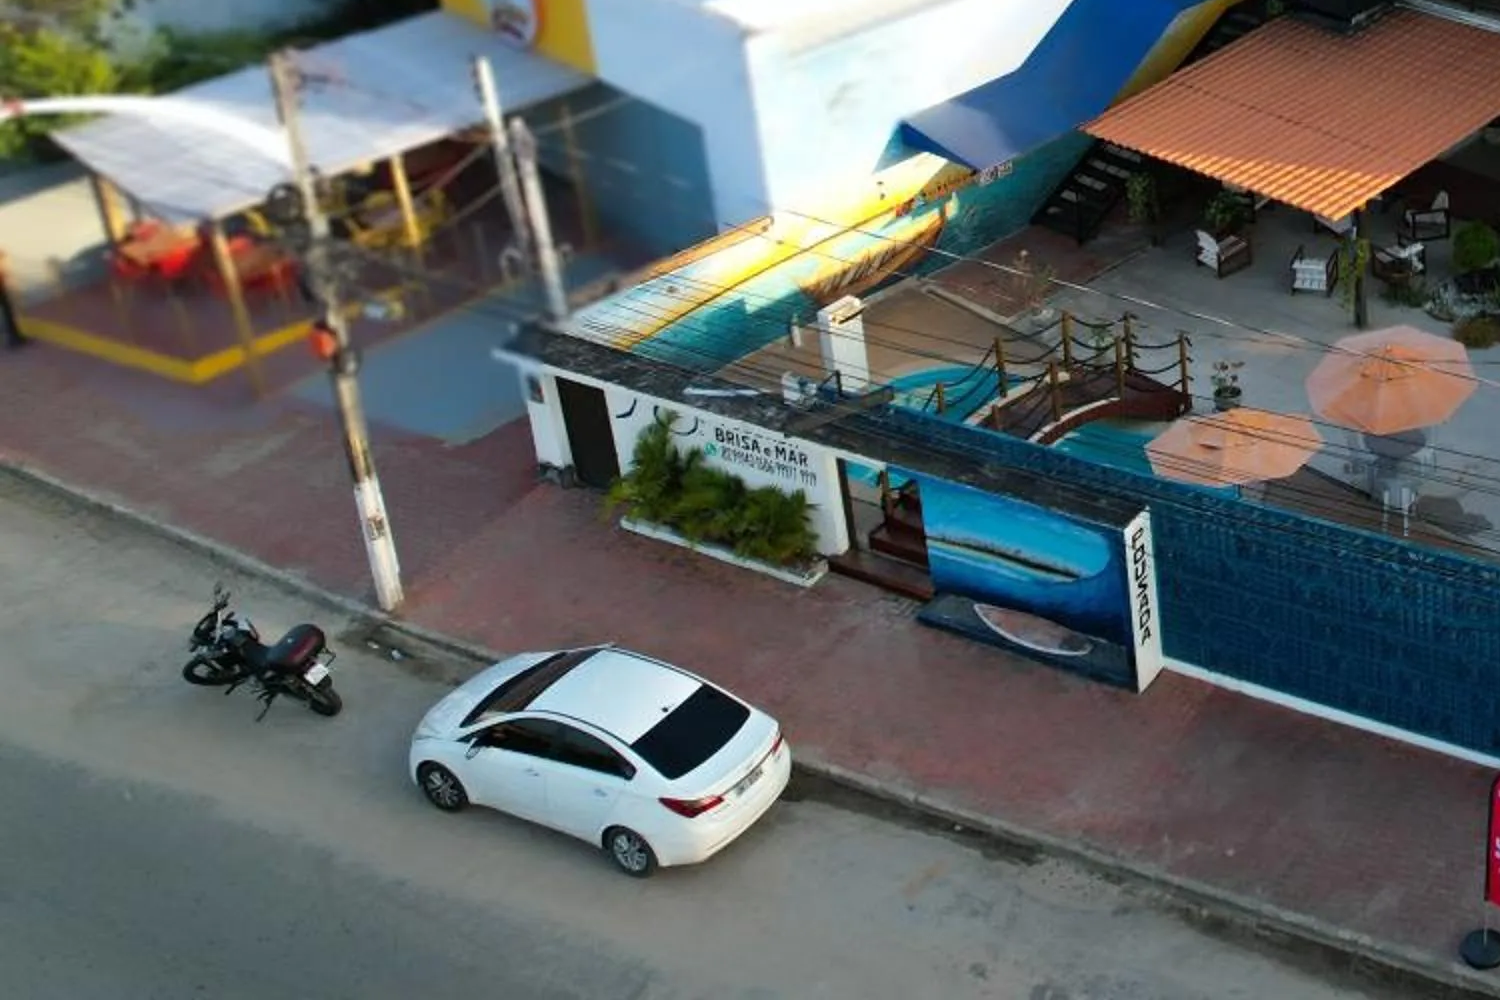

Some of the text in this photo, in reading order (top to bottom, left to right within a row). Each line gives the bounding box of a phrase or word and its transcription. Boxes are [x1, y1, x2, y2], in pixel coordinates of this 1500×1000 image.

[715, 427, 760, 453] BRISA
[775, 445, 809, 467] MAR
[1131, 527, 1152, 646] POUSADA
